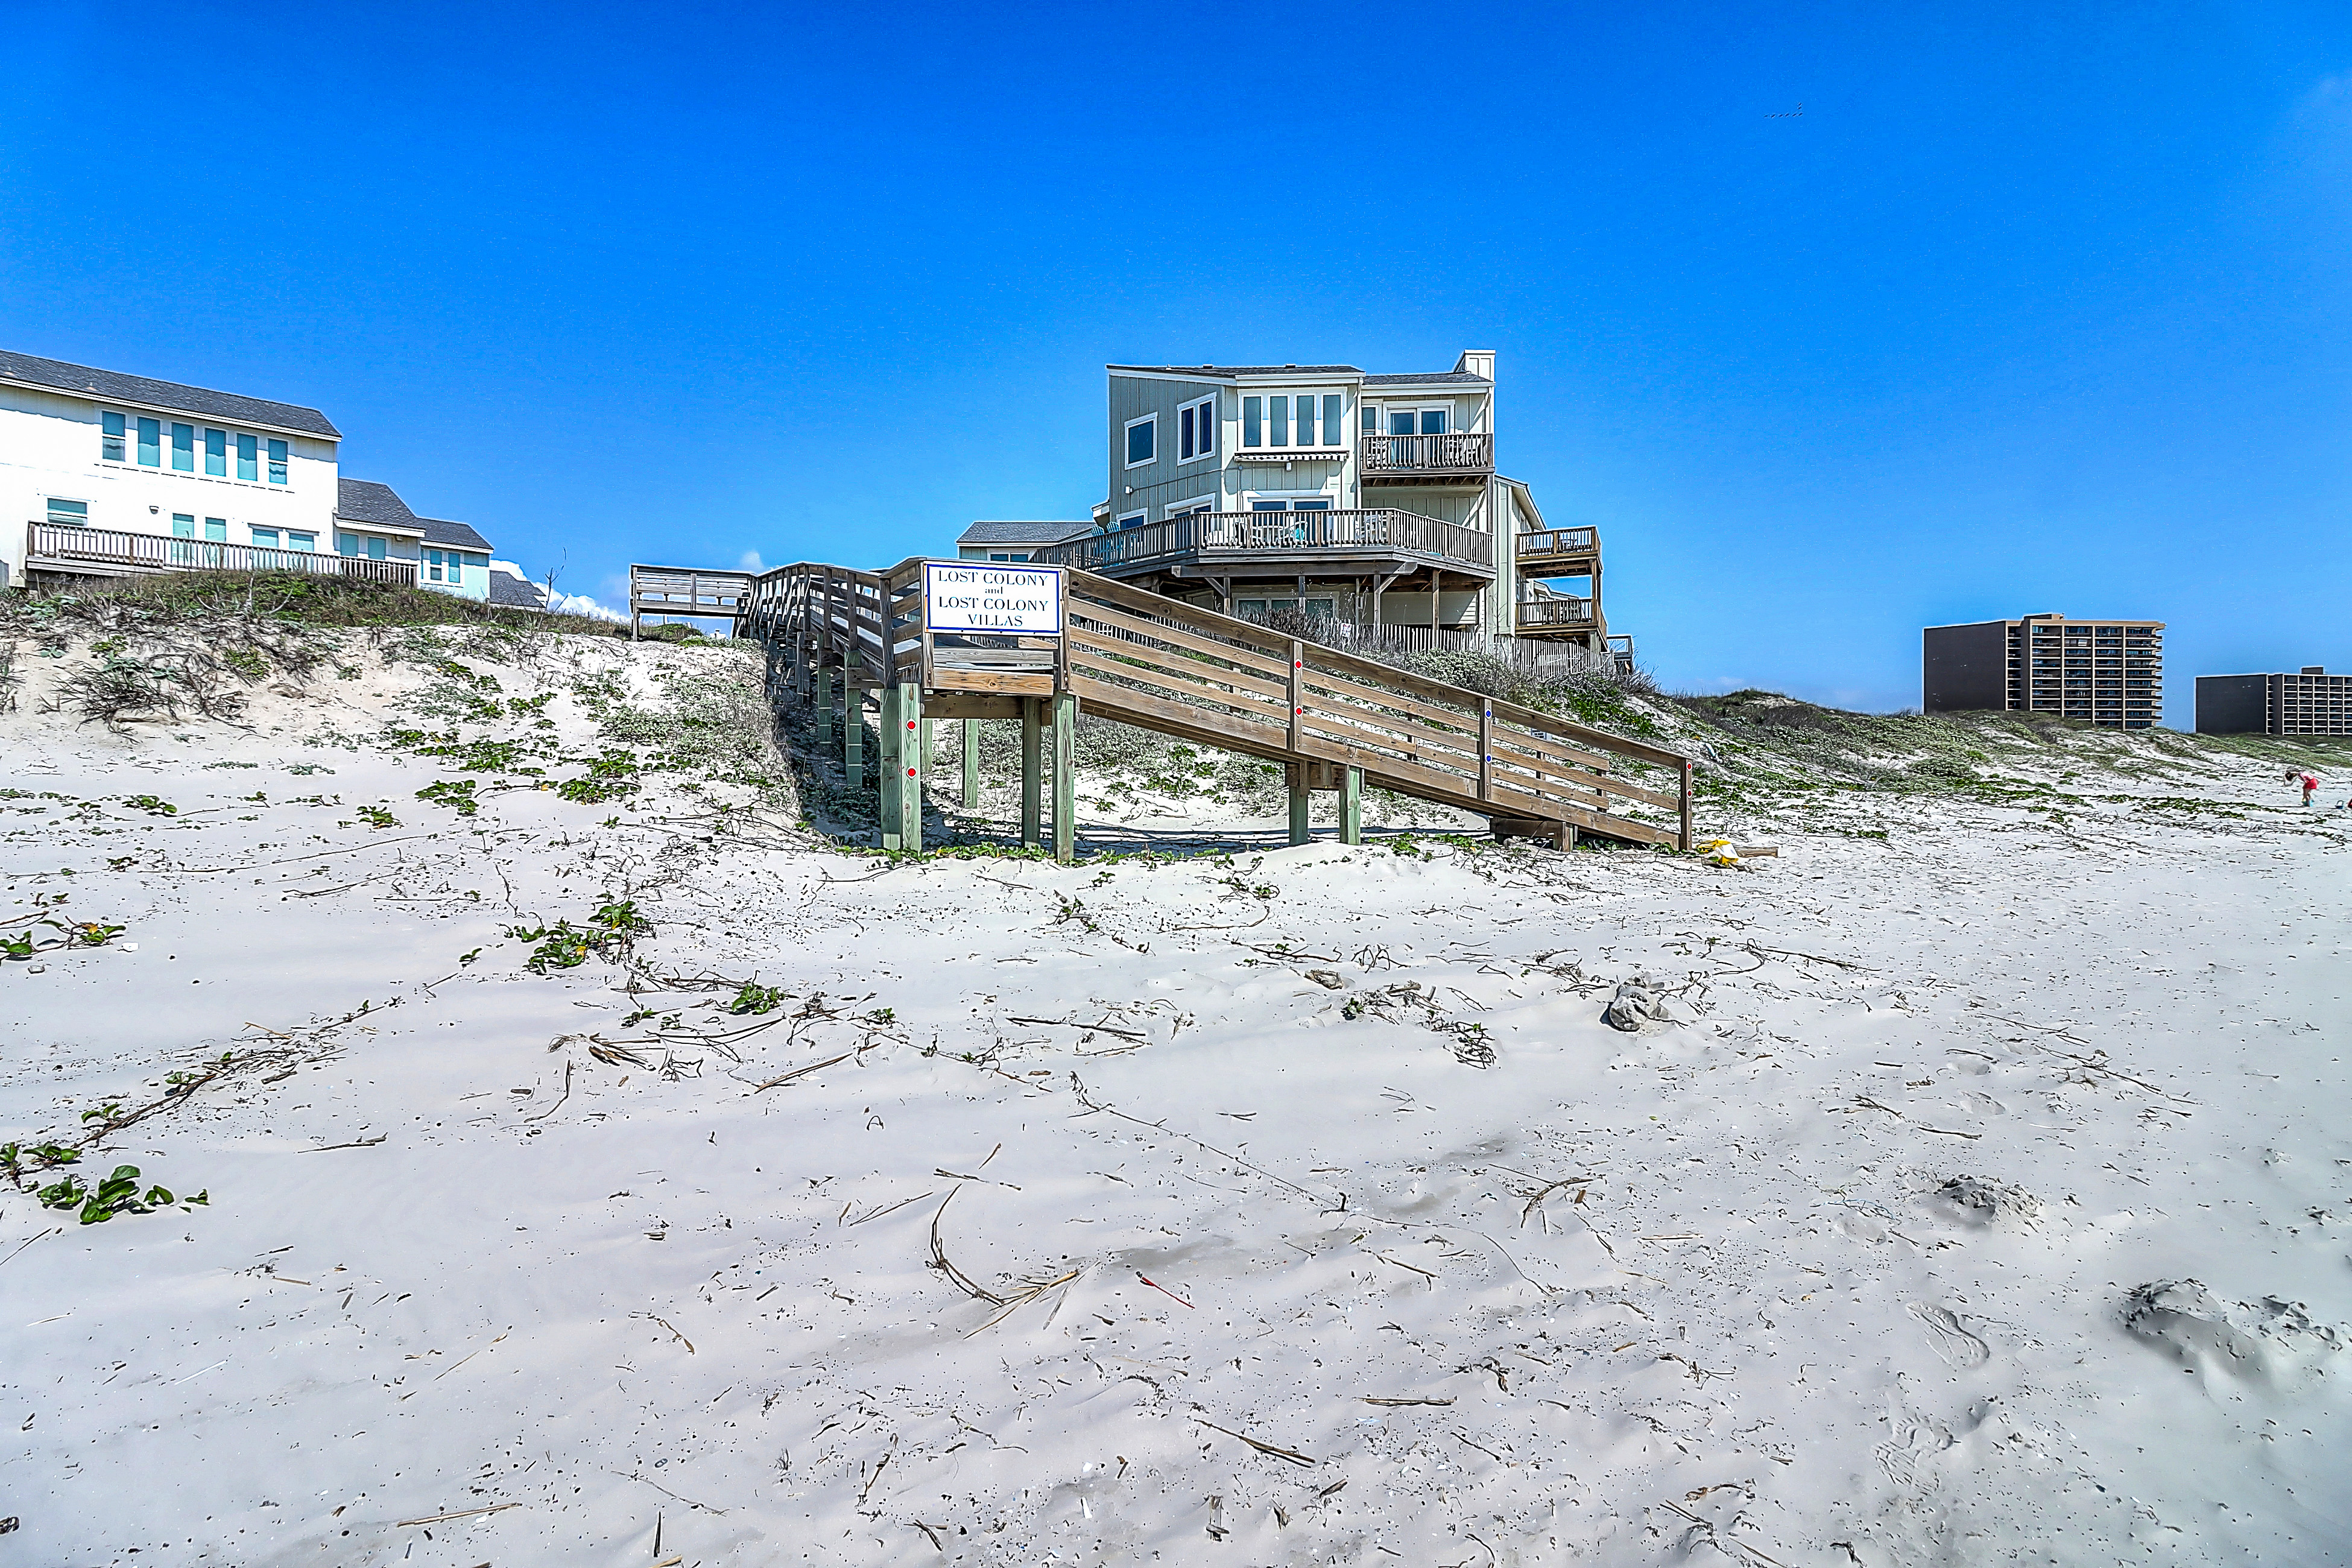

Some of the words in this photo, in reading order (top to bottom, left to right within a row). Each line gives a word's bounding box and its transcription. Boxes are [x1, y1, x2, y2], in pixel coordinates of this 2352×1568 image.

[938, 570, 978, 583] LOST
[984, 572, 1048, 586] COLONY
[985, 586, 1003, 595] and
[939, 596, 979, 609] LOST
[984, 598, 1049, 612] COLONY
[968, 614, 1023, 627] VILLAS
